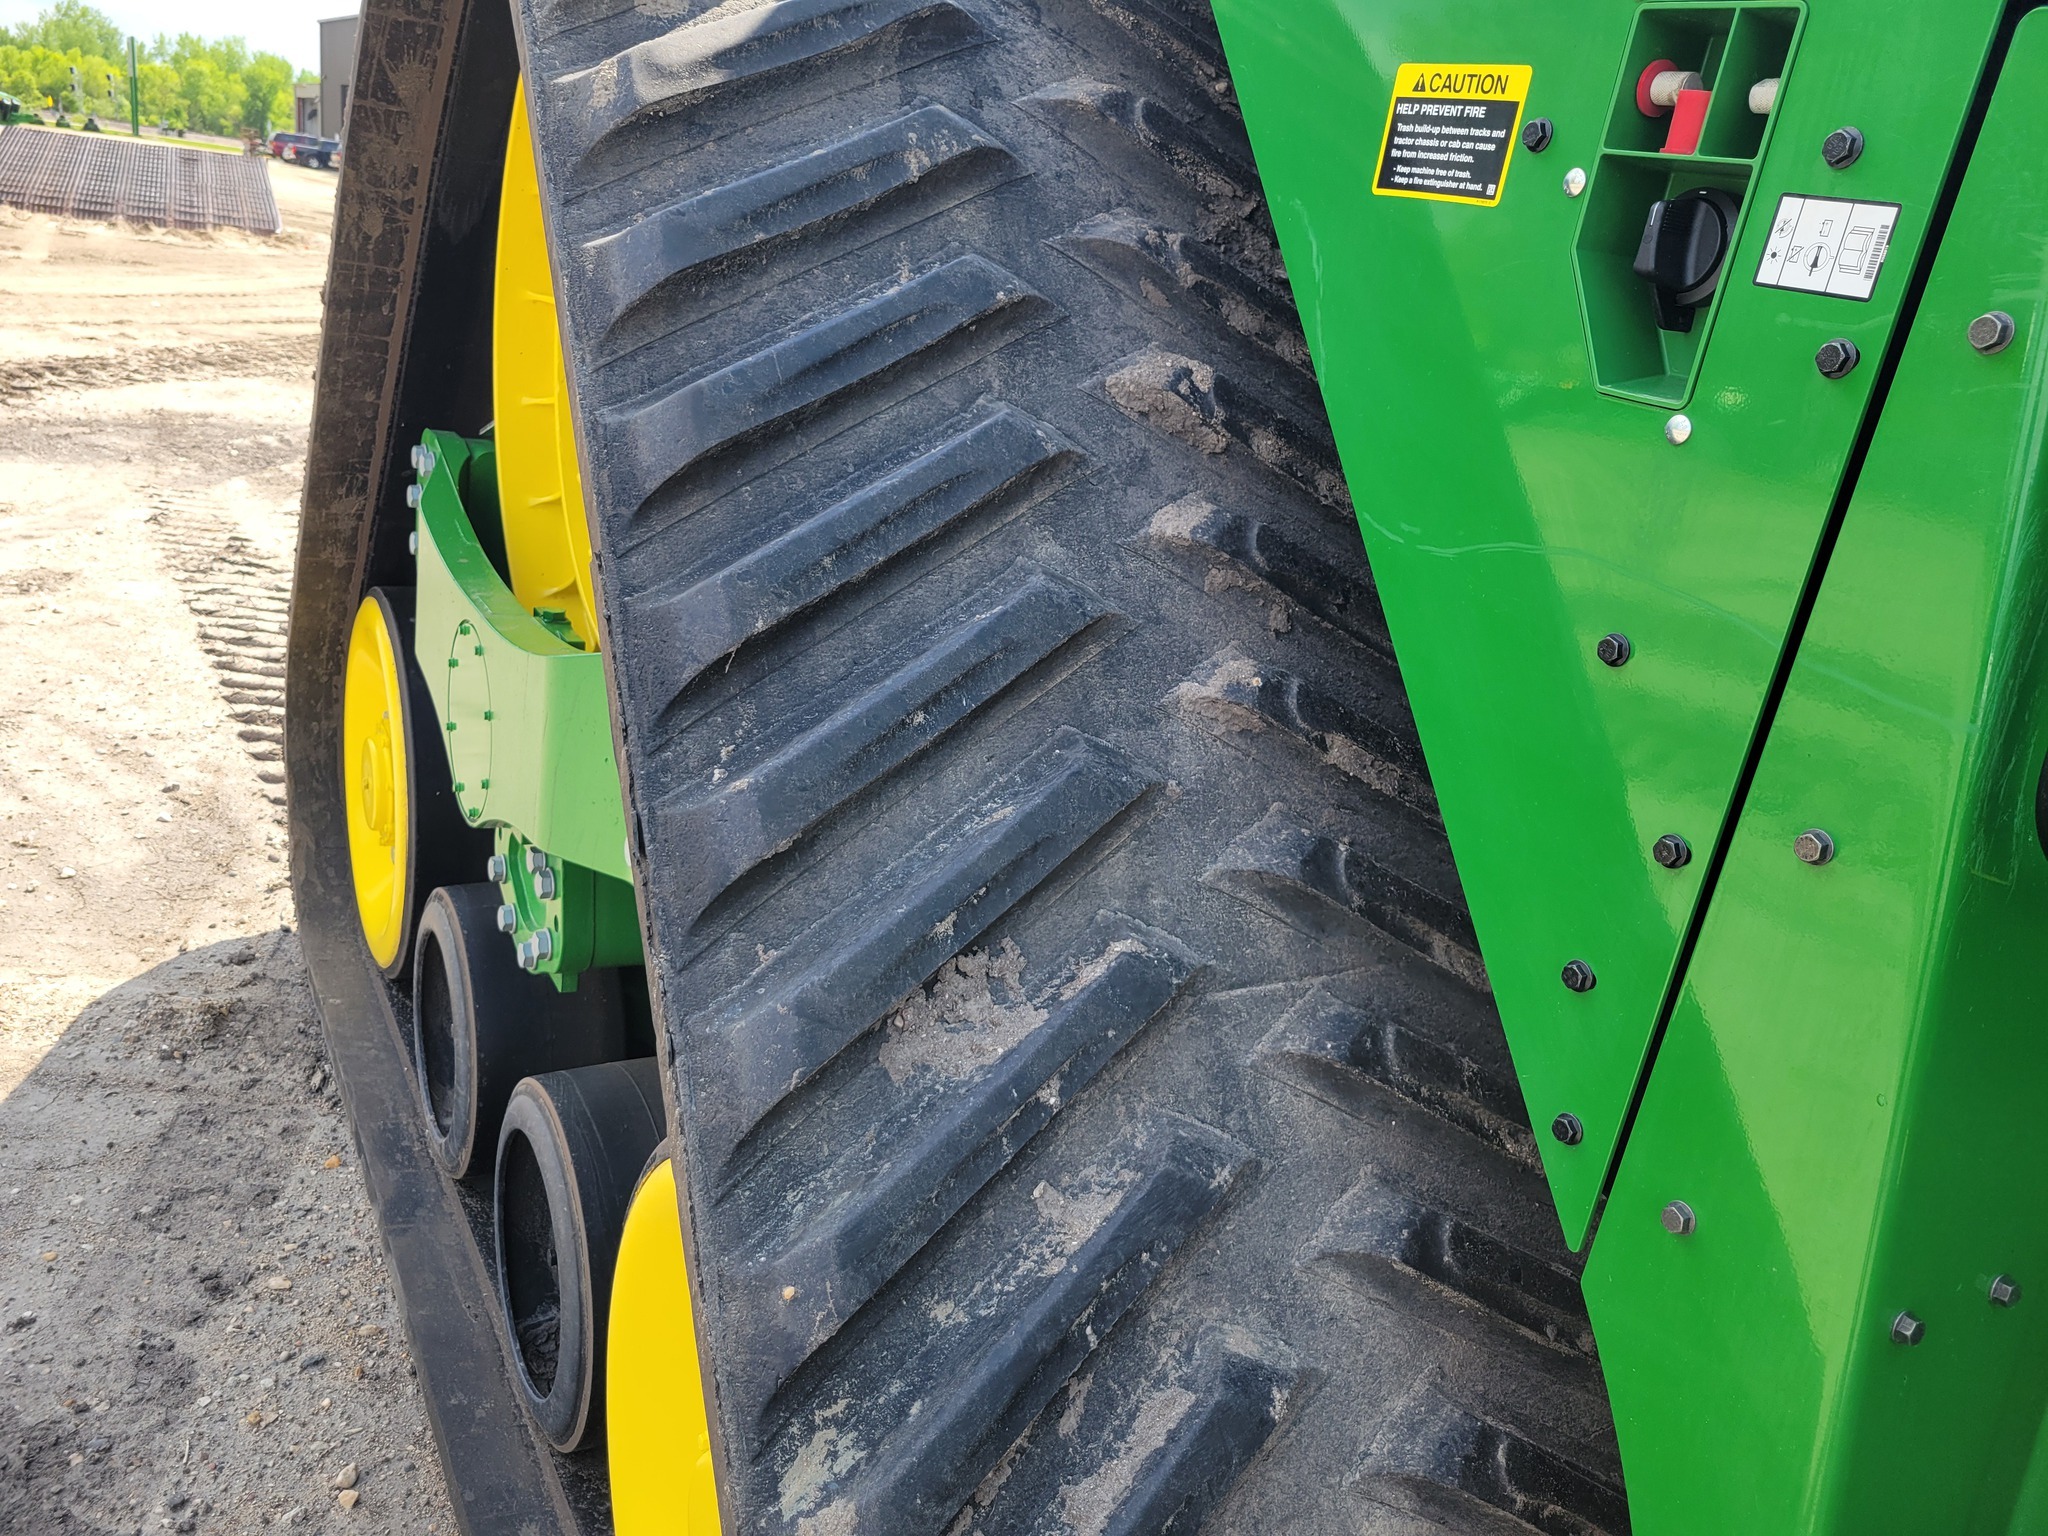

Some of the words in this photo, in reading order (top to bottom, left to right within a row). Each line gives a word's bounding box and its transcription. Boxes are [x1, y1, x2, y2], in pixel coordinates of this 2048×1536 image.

[1430, 73, 1509, 94] CAUTION
[1396, 103, 1419, 115] HELP
[1420, 104, 1463, 116] PREVENT
[1464, 106, 1486, 118] FIRE
[1398, 123, 1413, 132] Trash
[1415, 124, 1440, 135] build-up
[1441, 126, 1469, 136] between
[1470, 127, 1490, 137] tracks
[1492, 129, 1506, 138] and
[1394, 136, 1414, 145] tractor
[1415, 137, 1439, 146] chassis
[1448, 139, 1461, 148] cab
[1462, 142, 1474, 150] can
[1475, 143, 1495, 151] cause
[1391, 149, 1401, 157] fire
[1402, 149, 1416, 158] from
[1418, 150, 1448, 161] increased
[1450, 152, 1474, 163] friction.
[1396, 165, 1410, 174] Keep
[1411, 166, 1434, 175] machine
[1435, 168, 1447, 176] free
[1455, 170, 1471, 178] trash.
[1394, 176, 1408, 185] Keep
[1414, 177, 1423, 185] fire
[1424, 178, 1458, 189] extinguisher
[1466, 182, 1482, 191] hand.
